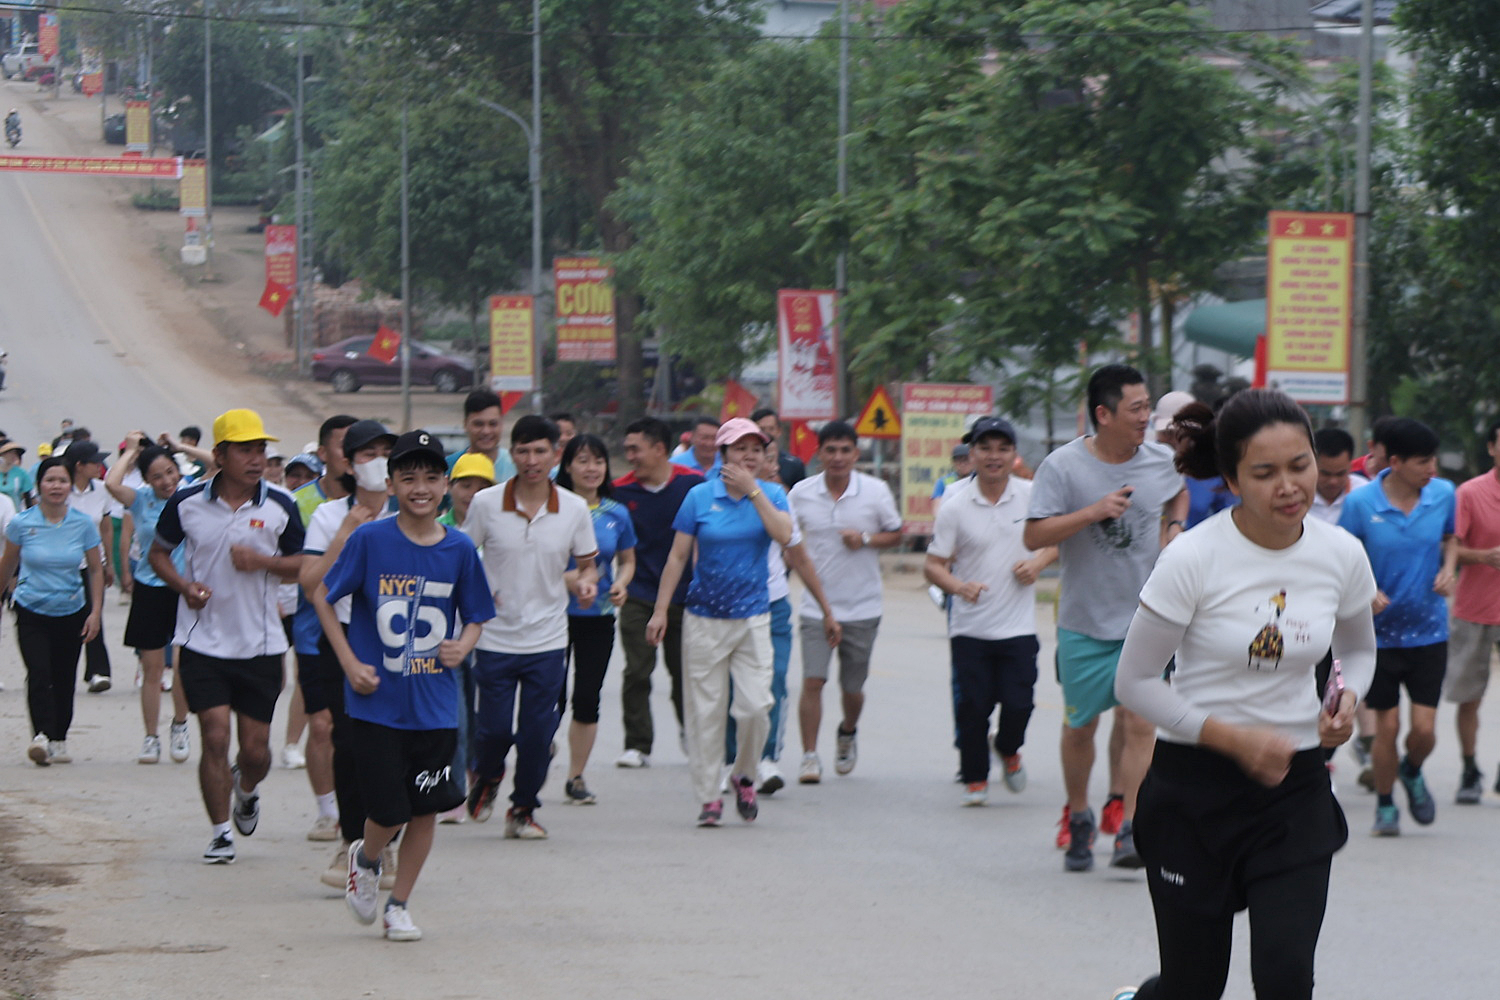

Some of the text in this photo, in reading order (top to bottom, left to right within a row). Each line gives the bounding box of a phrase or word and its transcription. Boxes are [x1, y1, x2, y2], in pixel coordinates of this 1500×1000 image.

[419, 433, 430, 446] C
[379, 578, 416, 597] NYC
[376, 581, 454, 673] 95
